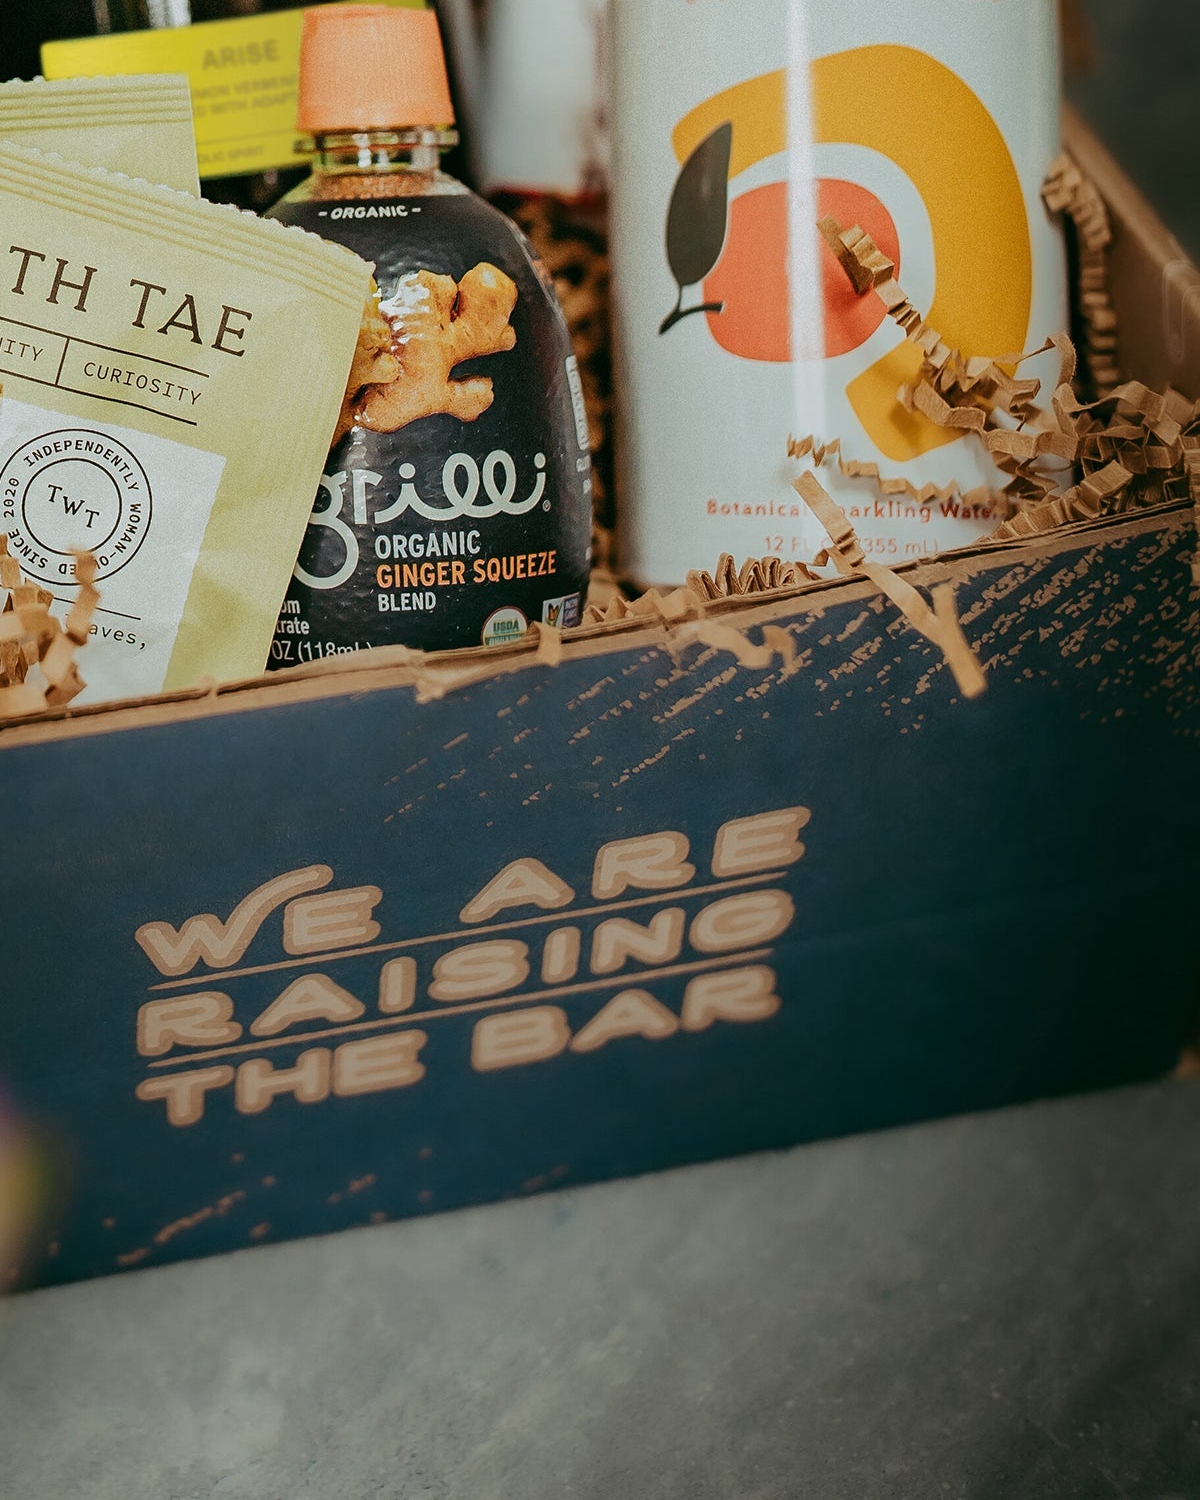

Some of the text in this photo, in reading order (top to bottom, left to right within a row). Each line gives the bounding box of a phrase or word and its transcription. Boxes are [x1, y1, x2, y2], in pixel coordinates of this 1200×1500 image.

[201, 39, 280, 72] ARISE
[330, 205, 409, 220] ORGANIC
[129, 278, 253, 358] TAE
[83, 361, 202, 406] CURIOSITY
[3, 439, 141, 575] INDEPENDENTLY WOMAN-OED SINCE 2020
[47, 483, 100, 529] TWT
[839, 500, 932, 524] arkling
[939, 501, 998, 521] Wate
[374, 529, 482, 560] ORGANIC
[763, 536, 785, 552] 12
[375, 549, 558, 590] GINGER SQUEEZE
[377, 591, 437, 613] BLEND
[493, 619, 520, 633] USDA
[134, 805, 812, 977] WE ARE
[136, 888, 796, 1056] RAISING
[134, 964, 783, 1128] THE BAR
